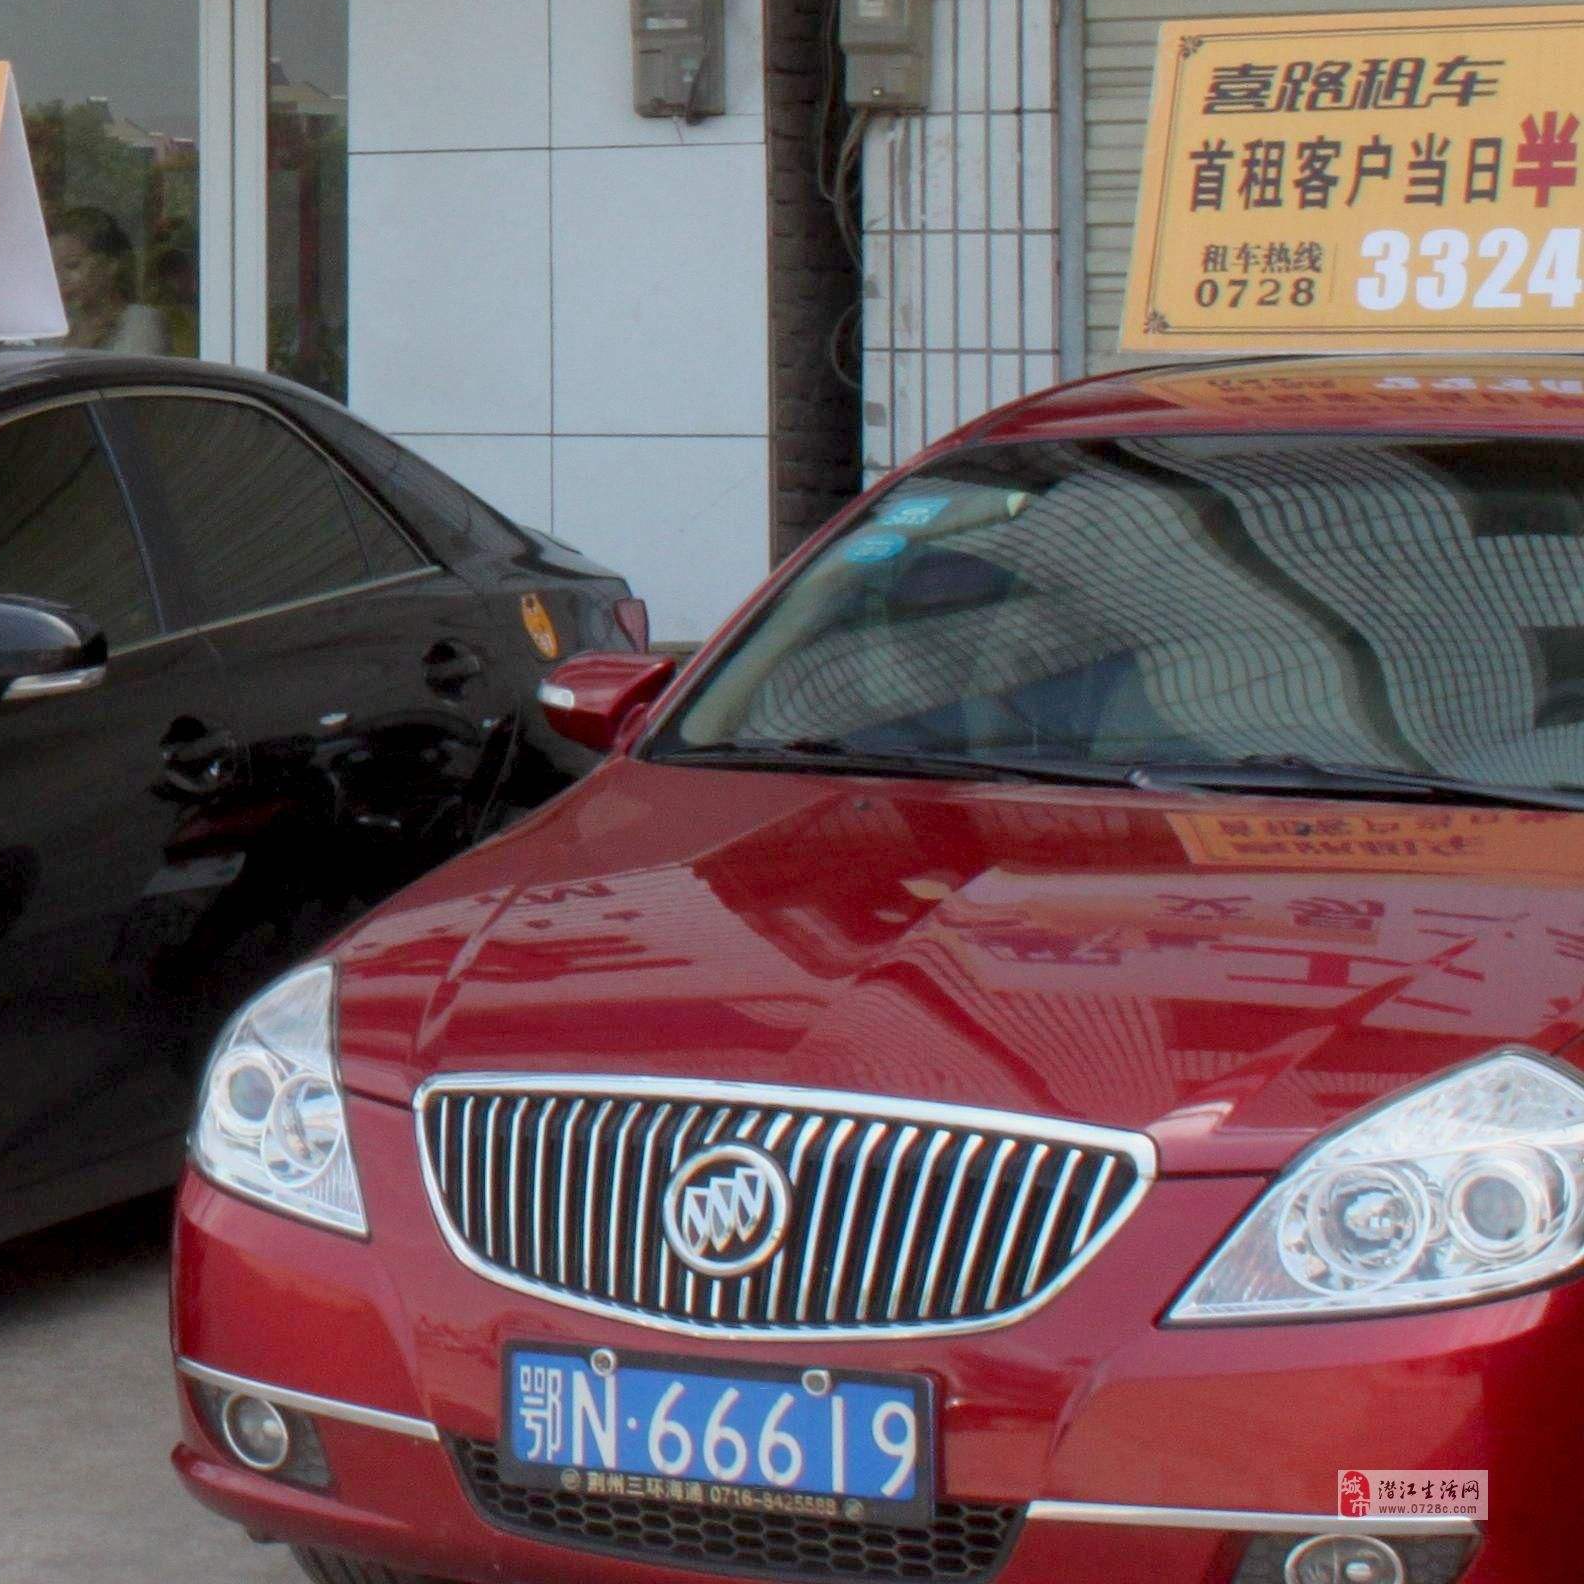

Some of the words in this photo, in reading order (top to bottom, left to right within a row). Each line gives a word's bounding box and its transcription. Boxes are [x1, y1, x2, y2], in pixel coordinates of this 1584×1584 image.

[1202, 56, 1505, 115] 喜路租车
[1201, 241, 1324, 275] 租车热线
[1194, 277, 1317, 309] 0728
